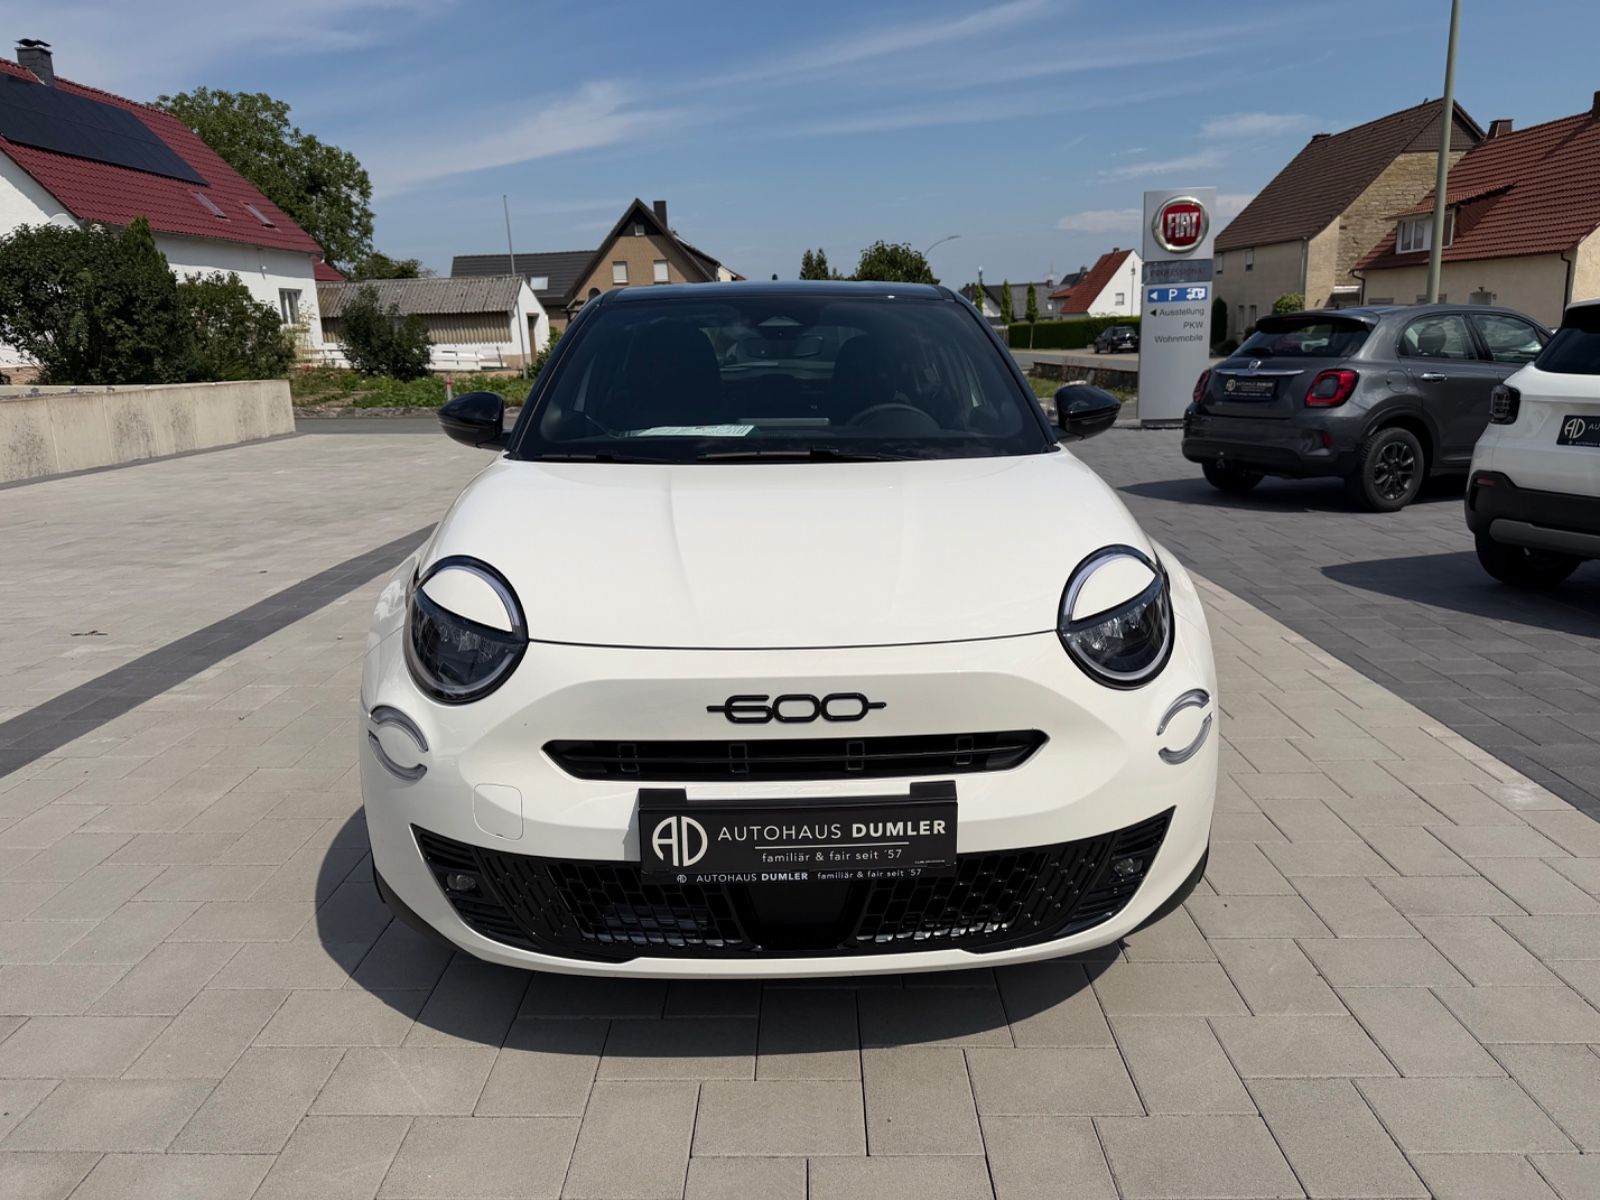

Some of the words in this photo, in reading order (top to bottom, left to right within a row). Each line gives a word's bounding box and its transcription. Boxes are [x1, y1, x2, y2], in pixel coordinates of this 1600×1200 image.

[1166, 212, 1200, 239] FIAT
[1168, 288, 1179, 301] P
[1159, 308, 1205, 317] Ausstellung
[1183, 321, 1204, 329] PKW
[1154, 334, 1204, 344] Wohnmobile
[1564, 418, 1586, 439] AD
[724, 692, 870, 724] 600
[717, 823, 842, 842] AUTOHAUS
[851, 819, 947, 839] DUMLER
[652, 815, 708, 867] AD
[761, 850, 810, 863] familiär
[815, 851, 824, 861] &
[829, 850, 851, 861] fair
[855, 850, 879, 860] seit
[696, 873, 758, 883] AUTOHAUS
[760, 871, 809, 882] DUMLER
[817, 871, 853, 880] familiär
[856, 870, 864, 879] &
[867, 869, 884, 878] fair
[886, 869, 905, 878] seit
